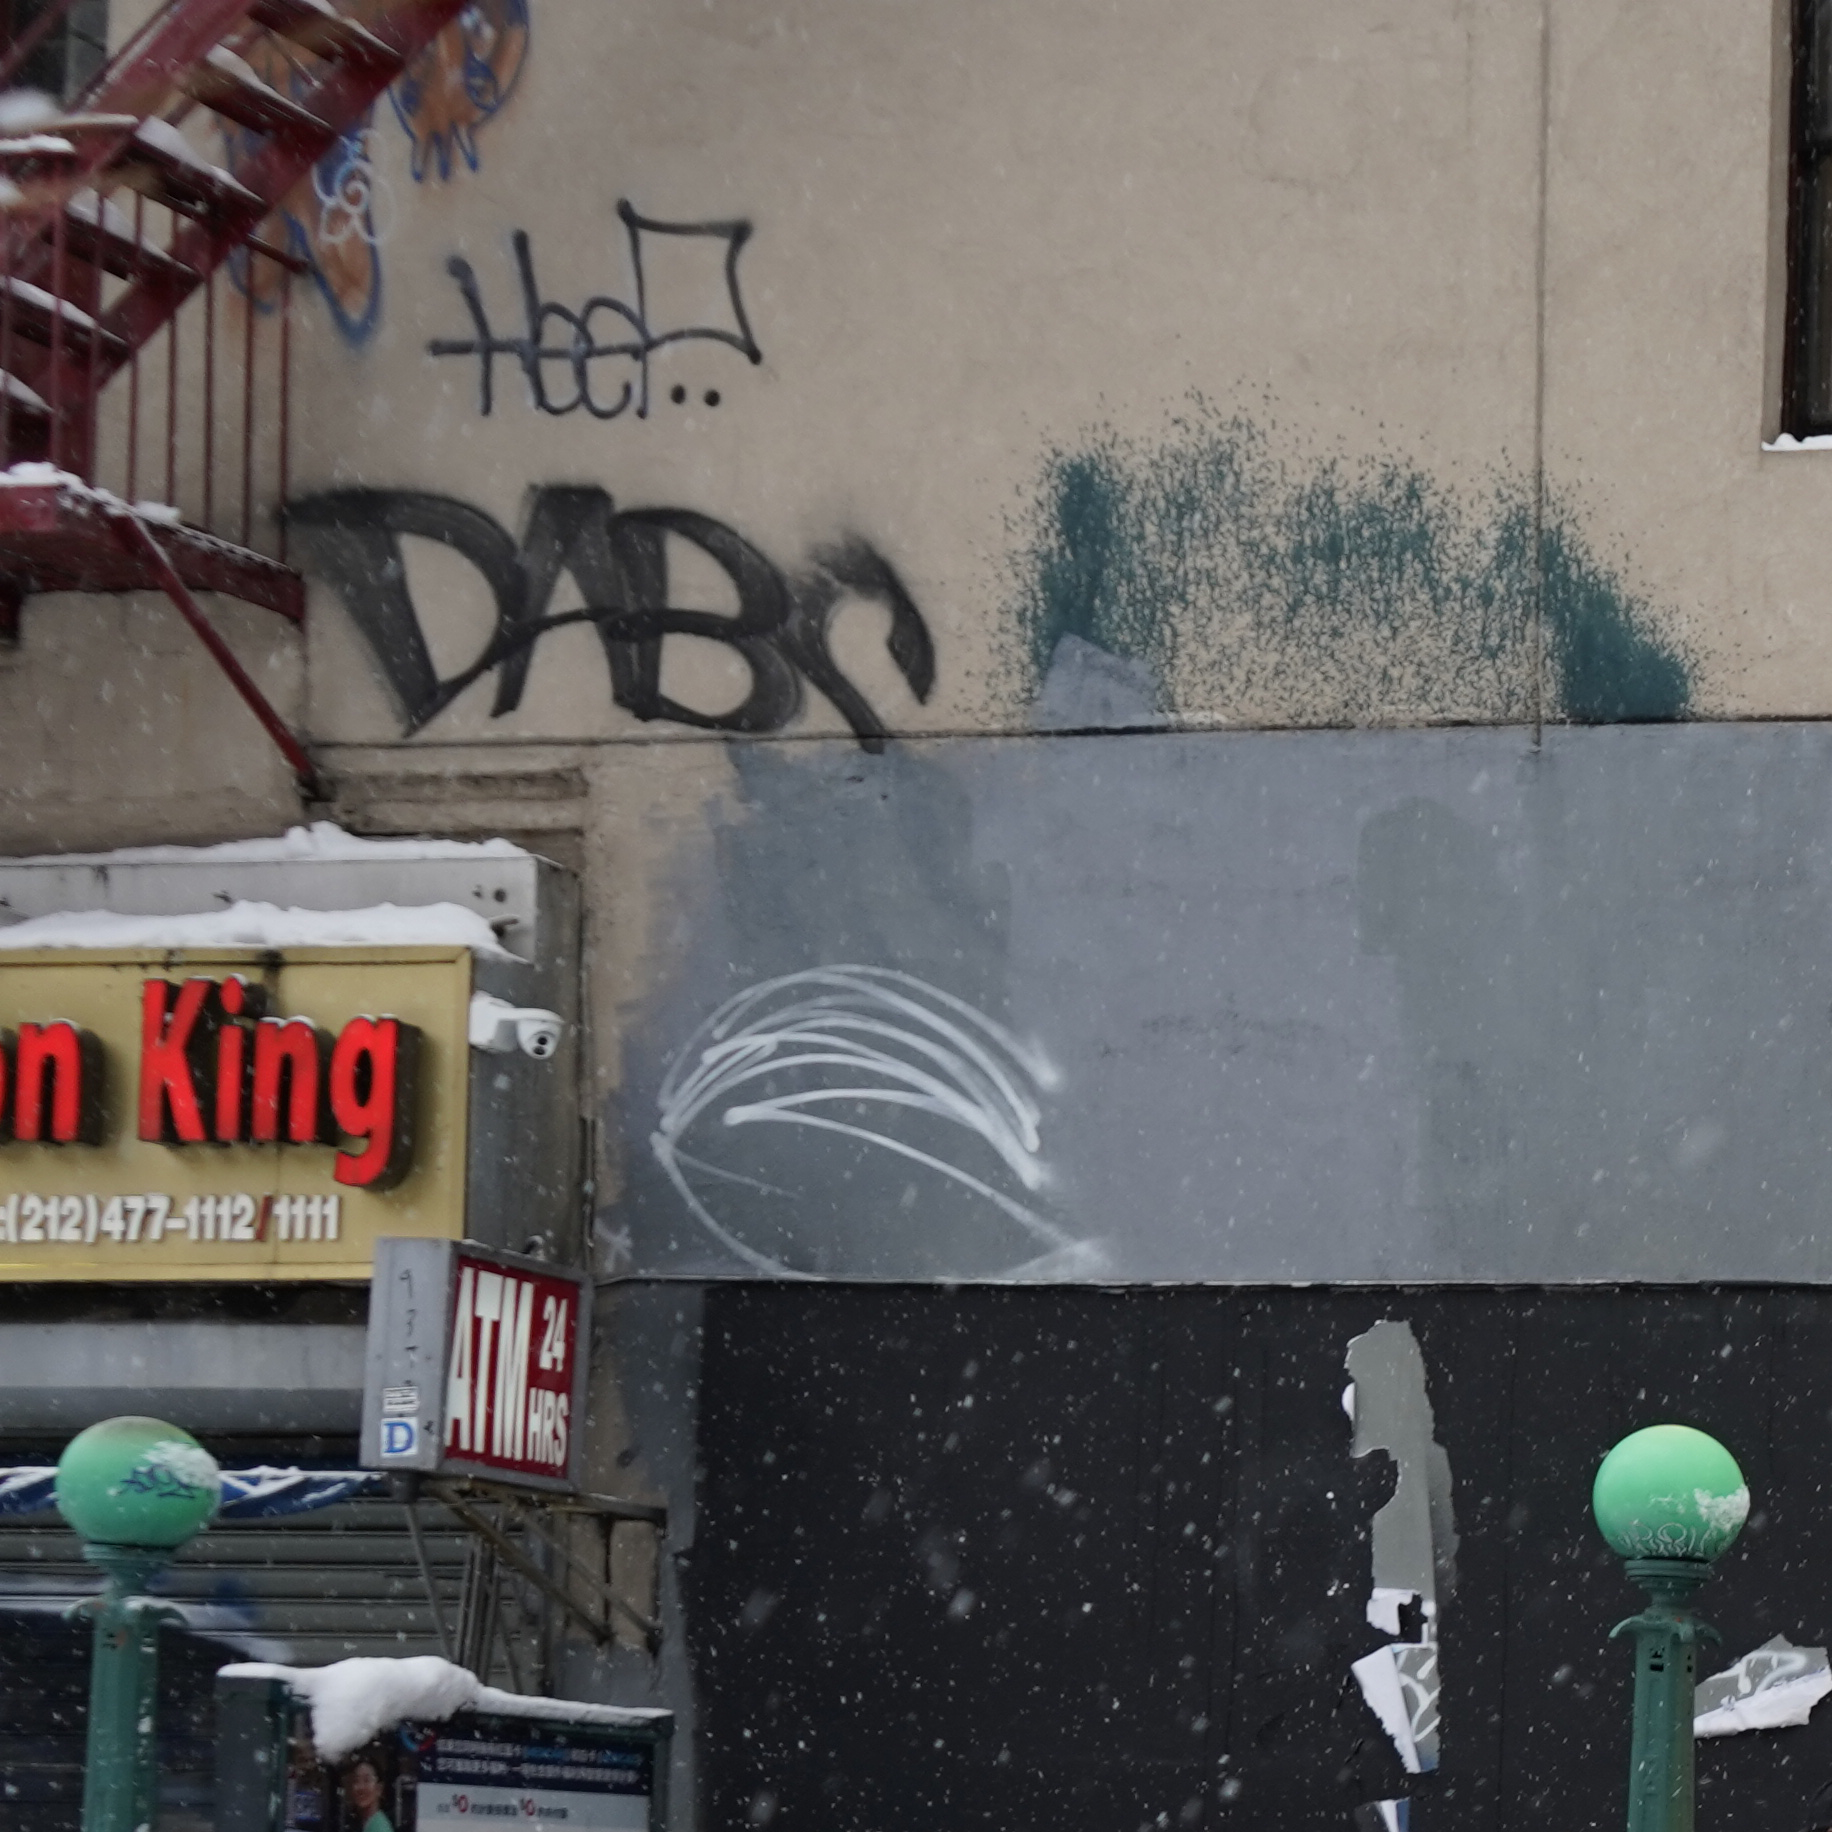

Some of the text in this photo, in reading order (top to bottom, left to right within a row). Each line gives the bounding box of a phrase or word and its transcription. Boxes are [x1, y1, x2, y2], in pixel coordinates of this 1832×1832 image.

[0, 973, 399, 1187] n King
[445, 1266, 534, 1461] ATM
[539, 1295, 568, 1372] 24
[385, 1422, 415, 1454] D
[527, 1387, 569, 1467] HRS
